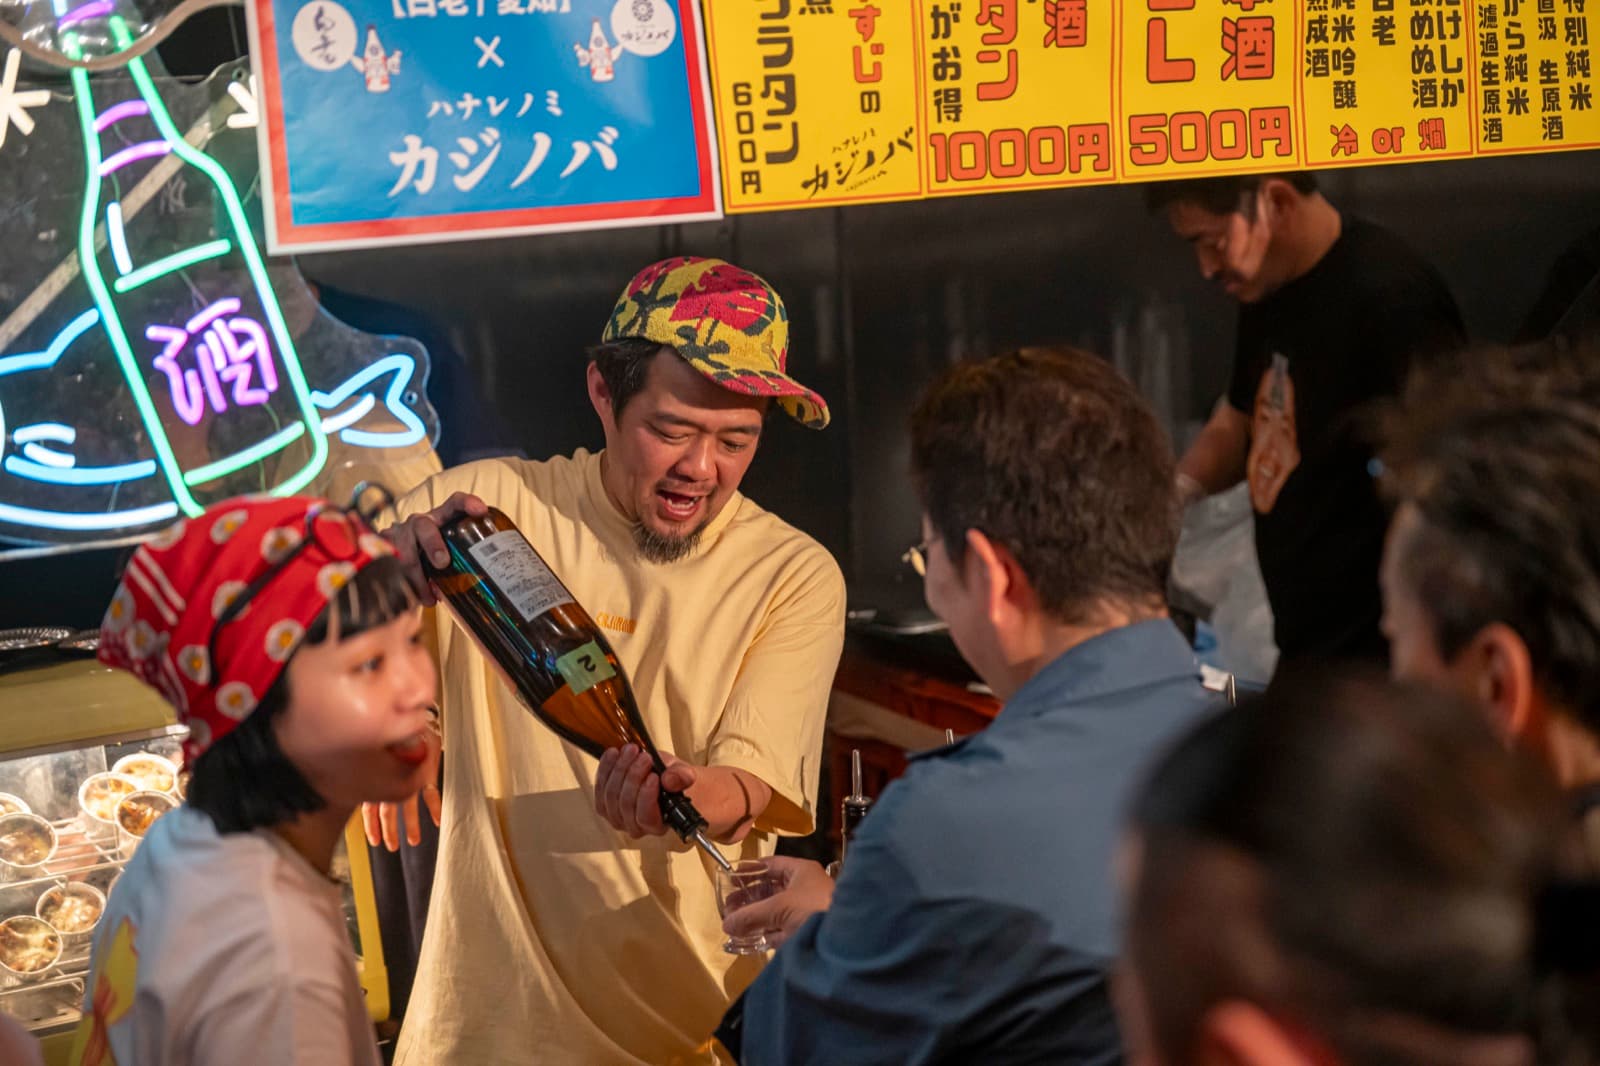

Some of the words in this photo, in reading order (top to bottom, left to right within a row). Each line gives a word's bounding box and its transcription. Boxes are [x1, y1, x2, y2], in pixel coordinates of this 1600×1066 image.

[930, 3, 963, 123] がお得
[1409, 0, 1438, 109] めぬ酒
[1436, 0, 1465, 108] けしか
[427, 91, 564, 121] ハナレノミ
[1128, 106, 1293, 166] 500円
[1539, 59, 1564, 141] 生原酒
[388, 126, 620, 198] カジノバ
[733, 82, 762, 195] 600円
[801, 126, 915, 201] カジノバ
[929, 122, 1111, 183] 1000円
[1330, 123, 1358, 157] 冷
[1372, 126, 1405, 154] or
[577, 653, 597, 673] 2
